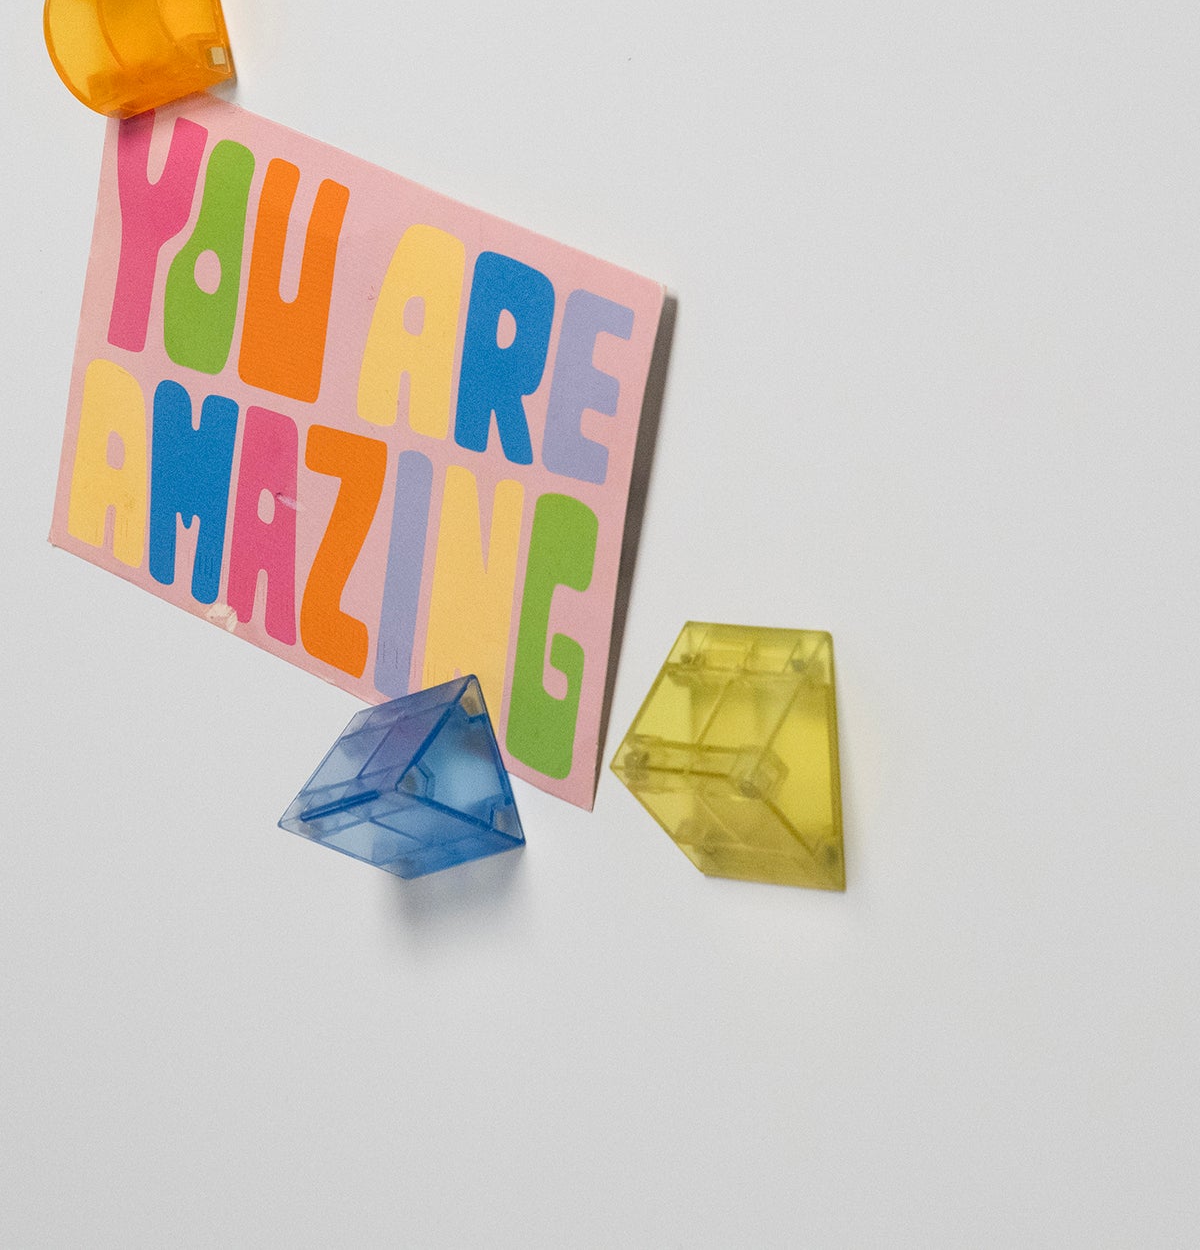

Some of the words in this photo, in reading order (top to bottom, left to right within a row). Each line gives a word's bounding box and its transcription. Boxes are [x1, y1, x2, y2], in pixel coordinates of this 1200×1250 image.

[107, 109, 350, 403] YOU
[357, 224, 635, 485] ARE
[67, 358, 599, 780] AMAZING
